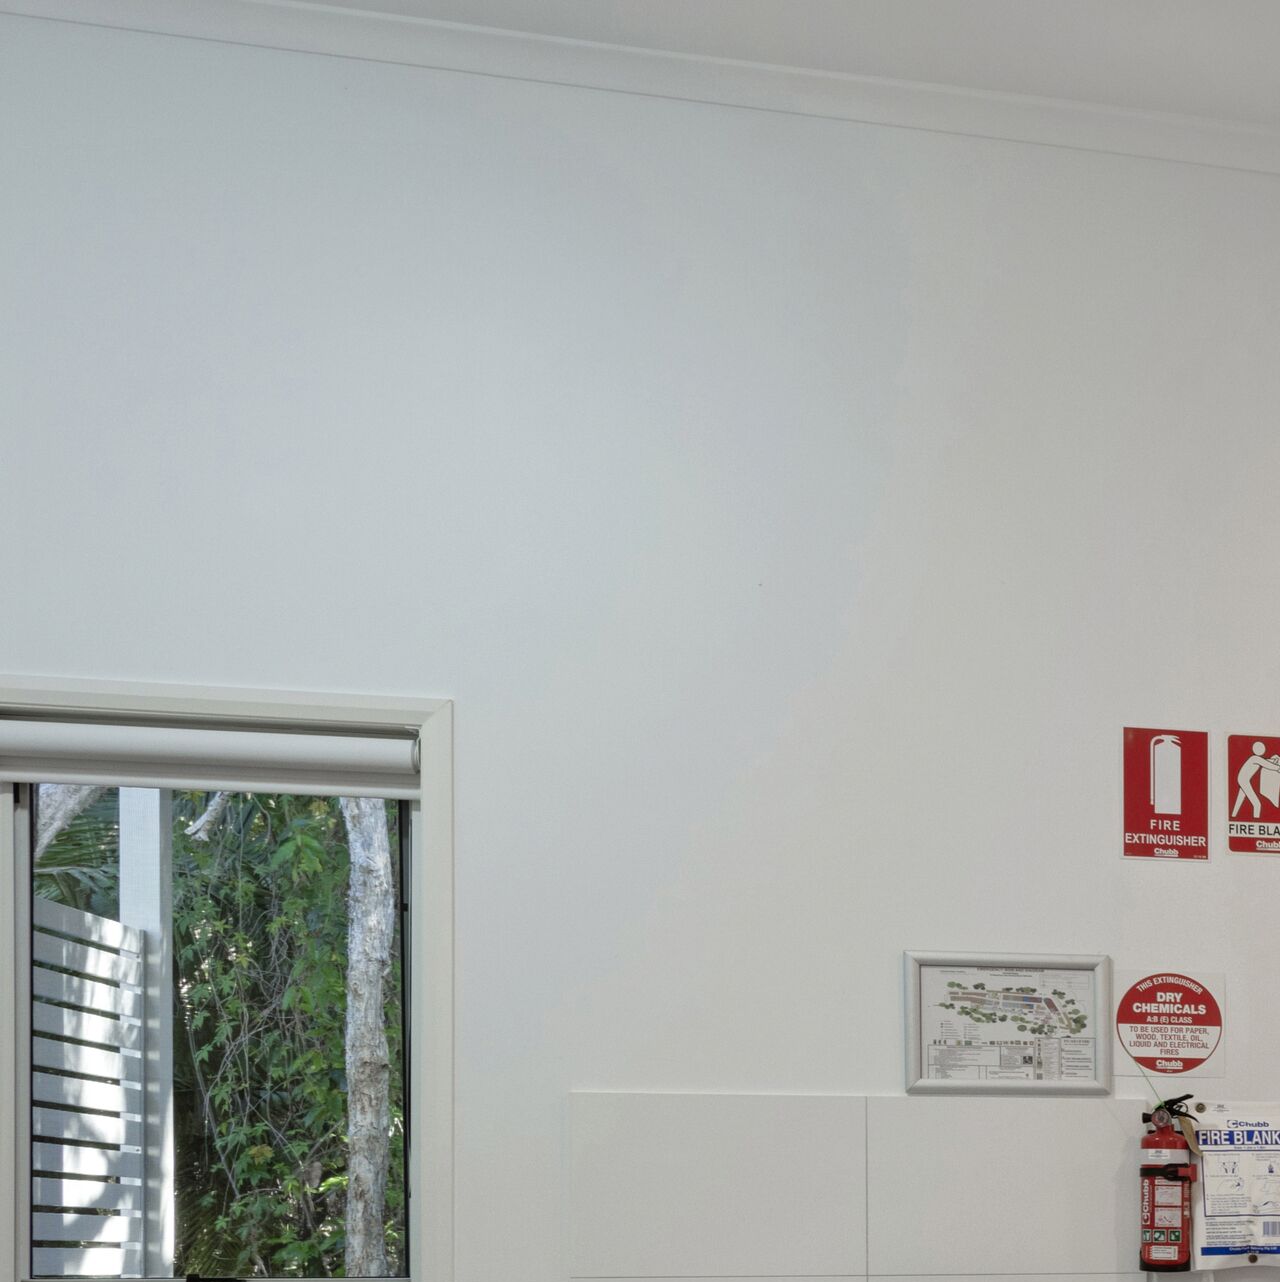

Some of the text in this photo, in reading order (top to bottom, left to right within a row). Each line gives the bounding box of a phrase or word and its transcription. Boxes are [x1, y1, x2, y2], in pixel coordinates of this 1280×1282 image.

[1150, 819, 1181, 831] FIRE
[1229, 824, 1255, 835] FIRE
[1125, 833, 1207, 847] EXTINGUISHER
[1154, 848, 1179, 856] Chubb
[1136, 976, 1203, 995] THIS EXTINGUISHER
[1156, 992, 1183, 1003] DRY
[1132, 1002, 1207, 1015] CHEMICALS
[1170, 1016, 1193, 1024] CLASS
[1170, 1026, 1184, 1034] FOR
[1198, 1130, 1230, 1145] FIRE
